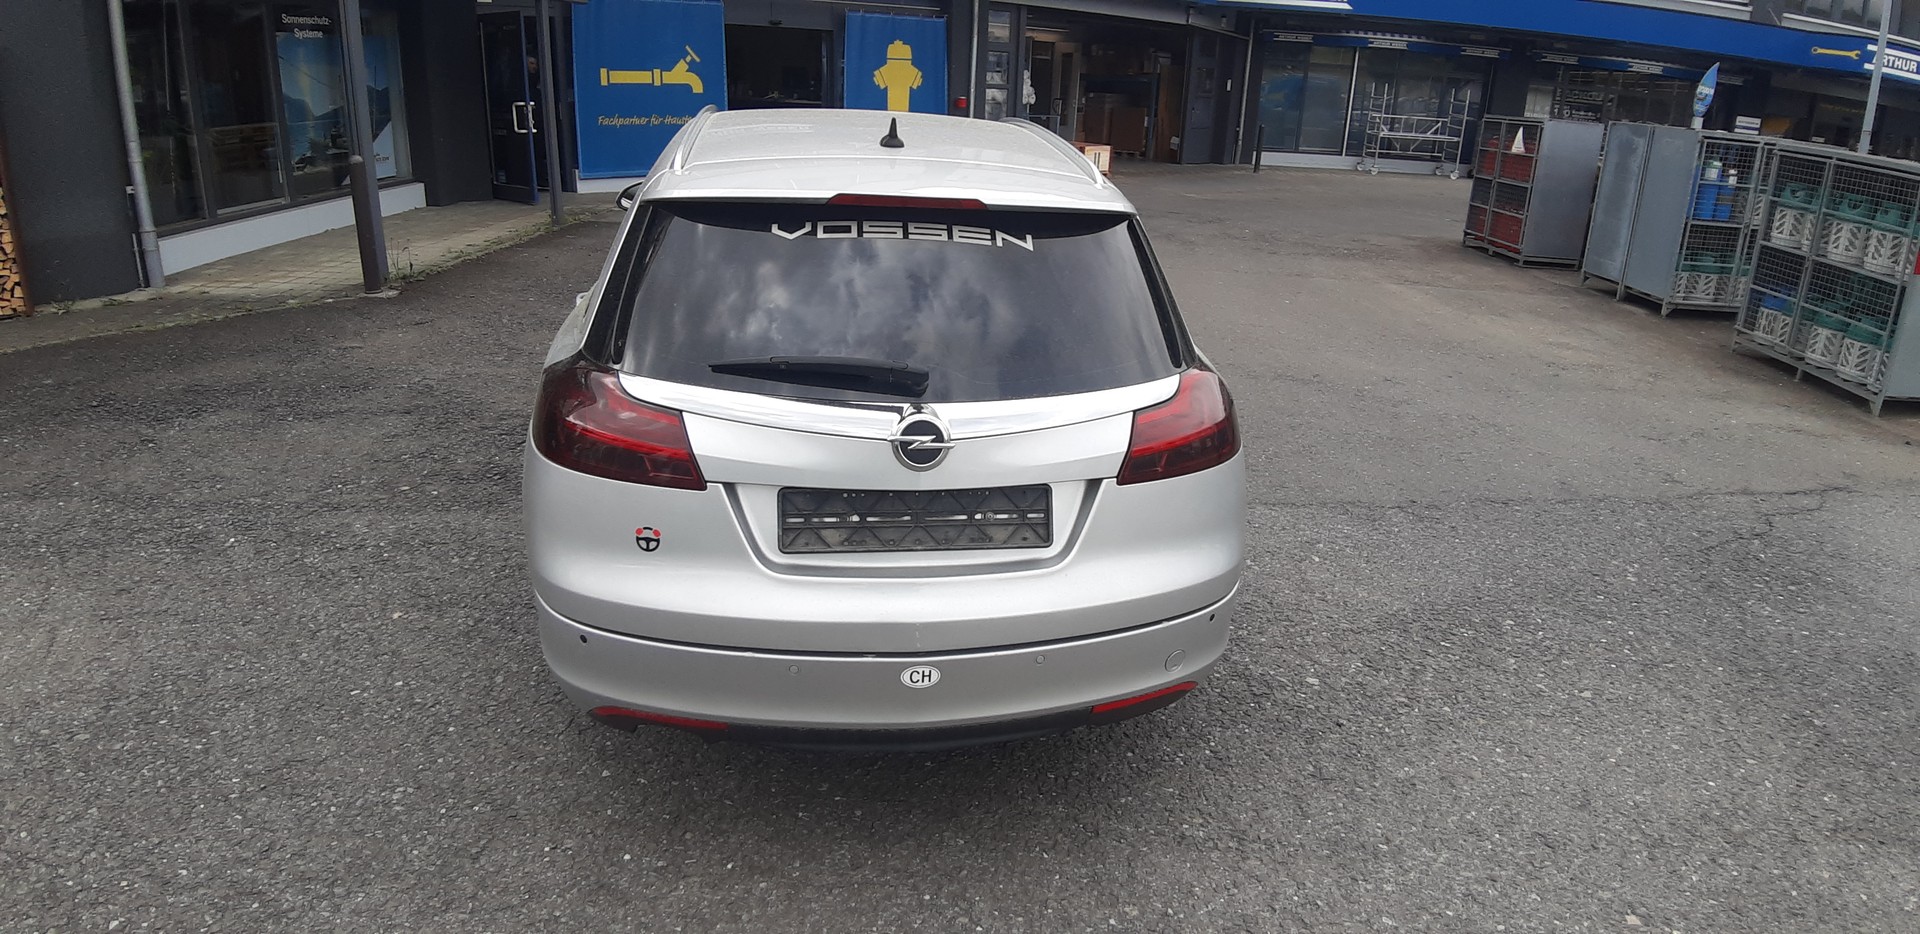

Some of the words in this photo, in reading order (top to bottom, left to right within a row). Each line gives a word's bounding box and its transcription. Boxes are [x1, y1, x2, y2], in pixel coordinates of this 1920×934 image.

[281, 13, 332, 25] Sonnenschutz-
[293, 28, 324, 39] Systeme
[1872, 53, 1918, 73] RTHUR
[598, 113, 648, 128] Fachpartner
[650, 114, 663, 126] für
[771, 220, 1034, 252] VOSSEN
[909, 669, 932, 684] CH
